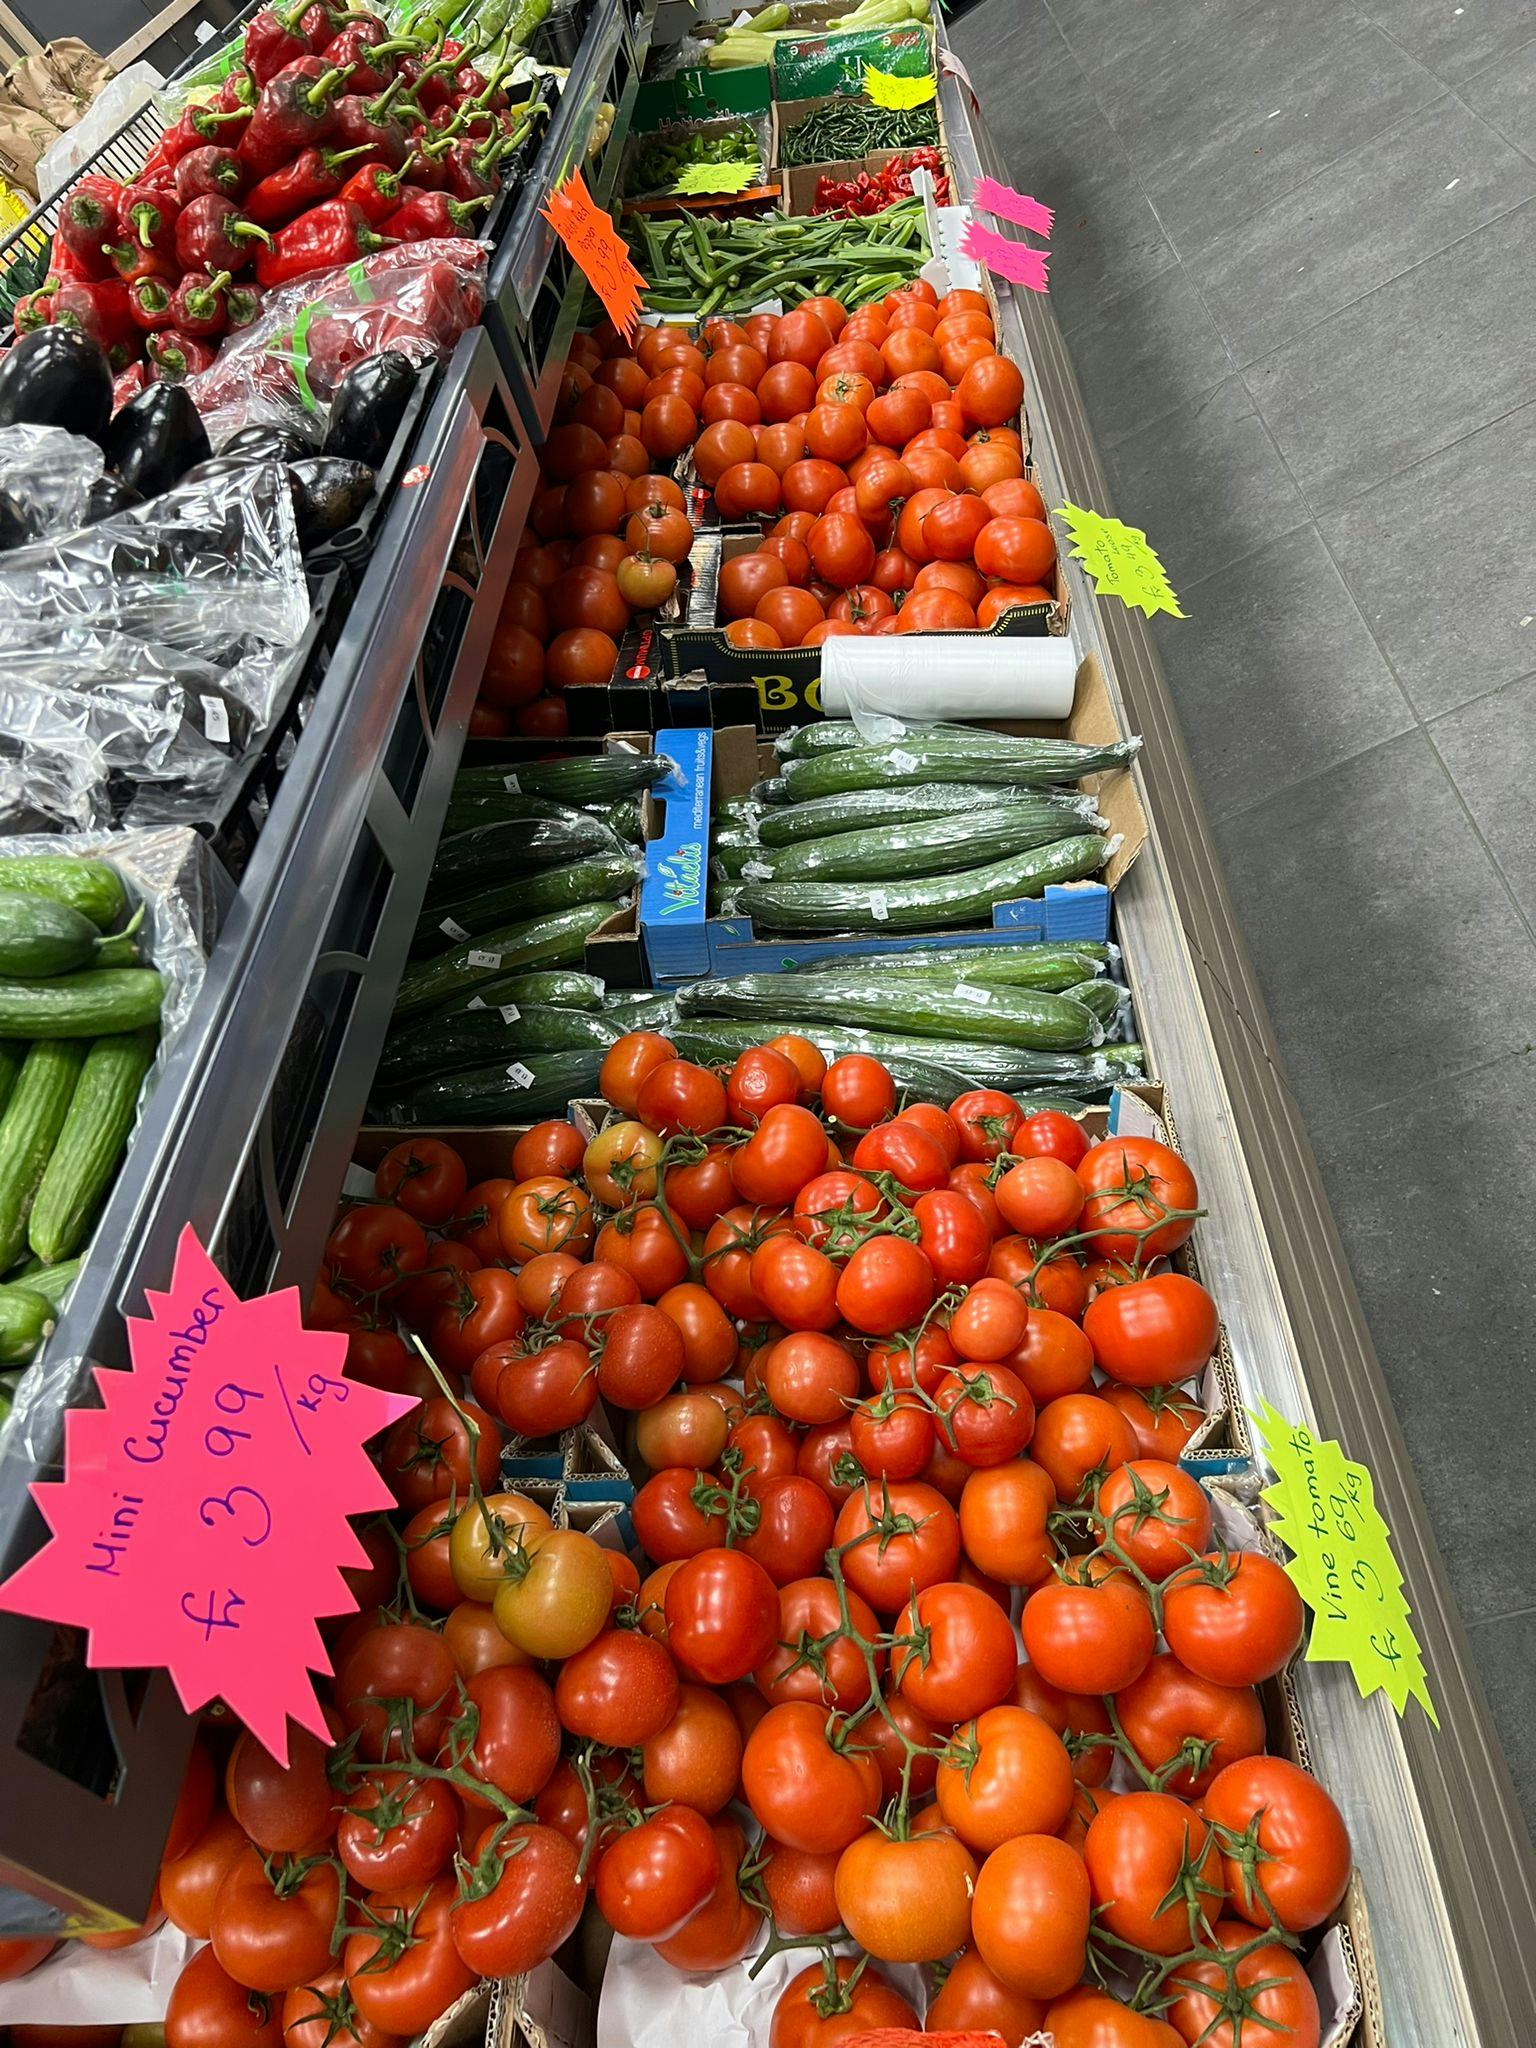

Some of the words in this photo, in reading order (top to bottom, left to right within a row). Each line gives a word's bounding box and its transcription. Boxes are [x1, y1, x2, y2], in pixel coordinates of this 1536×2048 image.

[1094, 540, 1119, 585] Tomato
[634, 629, 653, 666] OPTIMUM
[693, 731, 709, 772] fruits&vegs
[692, 774, 705, 830] mediterranean
[659, 842, 701, 916] Vitaelis
[85, 1491, 144, 1576] Mini
[123, 1287, 225, 1463] Cucumber
[204, 1382, 265, 1457] 99
[1288, 1430, 1330, 1539] tomato
[200, 1485, 272, 1547] 3
[1329, 1494, 1357, 1542] 69
[1321, 1551, 1348, 1621] Vine
[1351, 1559, 1385, 1602] 3
